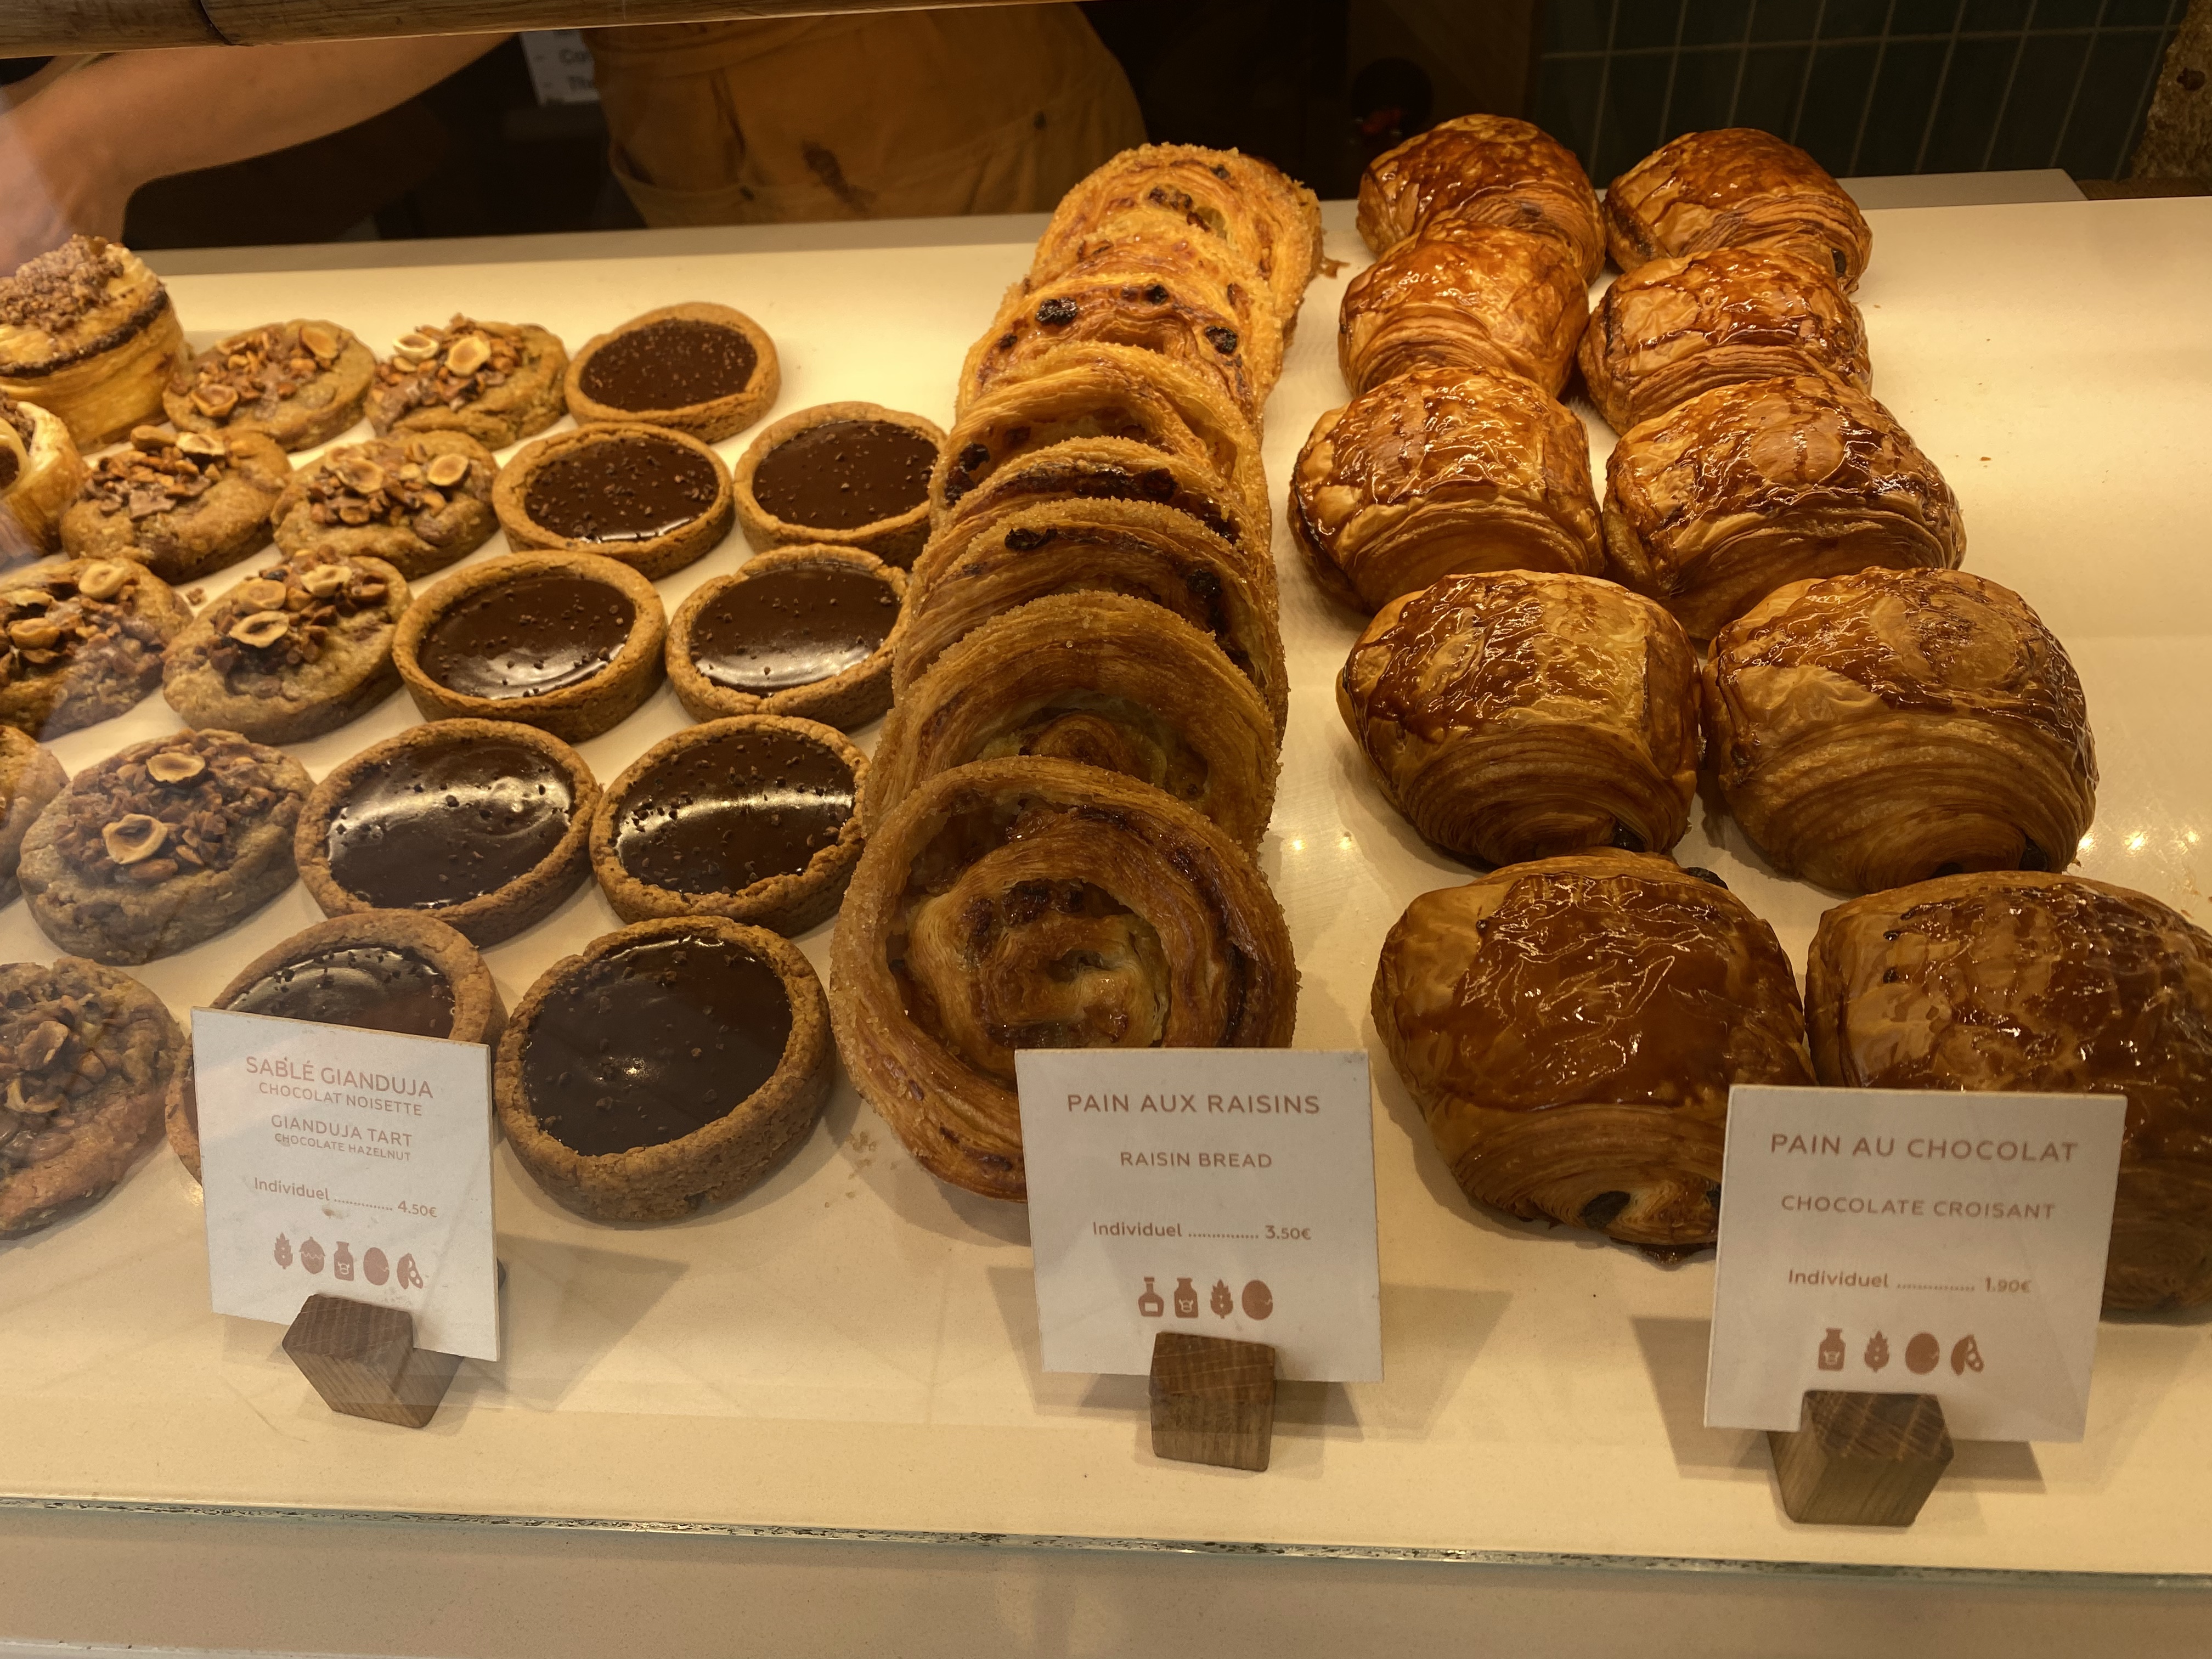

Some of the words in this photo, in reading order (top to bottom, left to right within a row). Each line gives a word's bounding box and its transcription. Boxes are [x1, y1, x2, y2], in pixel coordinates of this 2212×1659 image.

[246, 1056, 314, 1081] SABLÉ
[321, 1067, 433, 1098] GIANDUJA
[259, 1082, 342, 1104] CHOCOLAT
[346, 1095, 422, 1116] NOISETTE
[1068, 1095, 1129, 1113] PAIN
[1141, 1094, 1197, 1113] AUX
[1208, 1094, 1320, 1114] RAISINS
[271, 1114, 362, 1139] GIANDUJA
[367, 1128, 413, 1147] TART
[274, 1133, 345, 1152] CHOCOLATE
[348, 1144, 411, 1161] HAZELNUT
[1120, 1152, 1190, 1166] RAISIN
[1199, 1153, 1272, 1167] BREAD
[1771, 1133, 1841, 1154] PAIN
[1852, 1137, 1895, 1157] AU
[1907, 1138, 2078, 1161] CHOCOLAT
[254, 1177, 330, 1201] Individuel
[397, 1200, 437, 1217] 4.50€
[1781, 1195, 1925, 1215] CHOCOLATE
[1933, 1200, 2055, 1219] CROISANT
[1093, 1221, 1182, 1238] Individuel
[1265, 1224, 1311, 1240] 3.50€
[1788, 1269, 1888, 1288] Individuel
[1985, 1276, 2032, 1293] 1.90€
